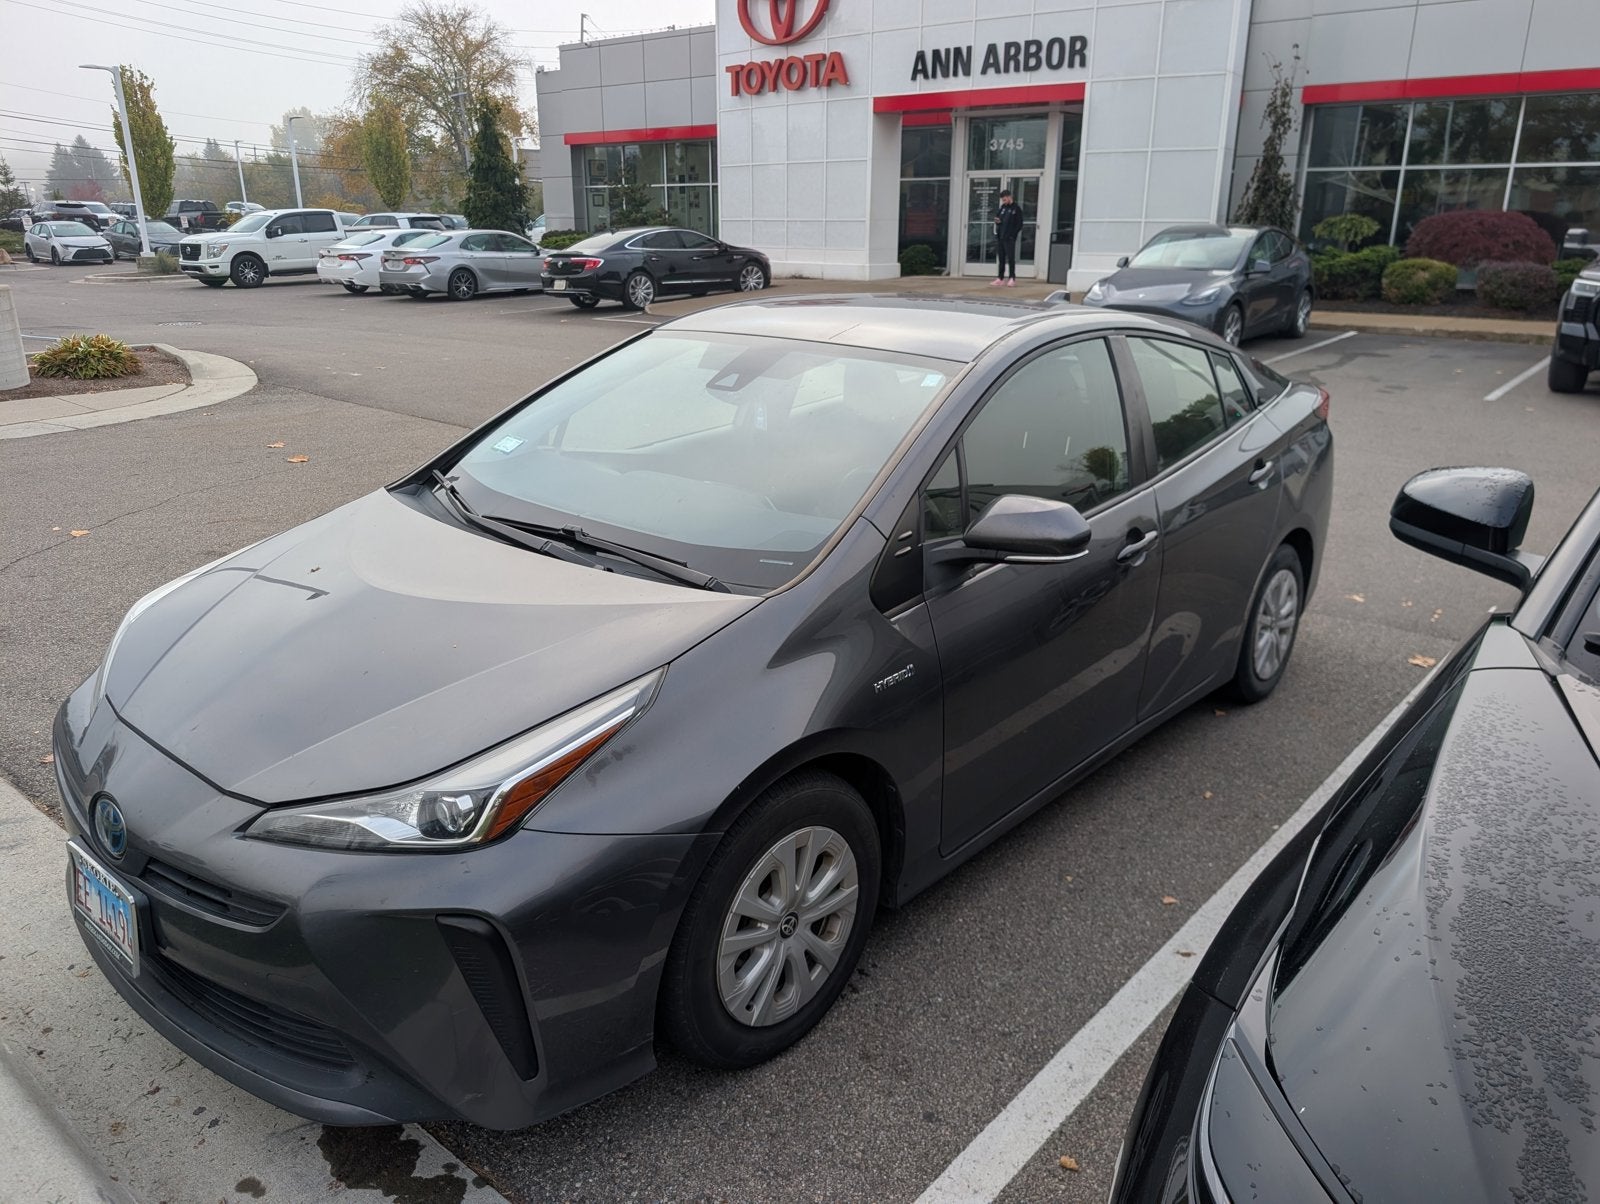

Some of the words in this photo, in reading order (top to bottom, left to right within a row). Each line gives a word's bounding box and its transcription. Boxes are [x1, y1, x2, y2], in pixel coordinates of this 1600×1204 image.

[725, 51, 850, 97] TOYOTA
[911, 45, 972, 81] ANN
[981, 35, 1088, 75] ARBOR
[989, 138, 1024, 151] 3745
